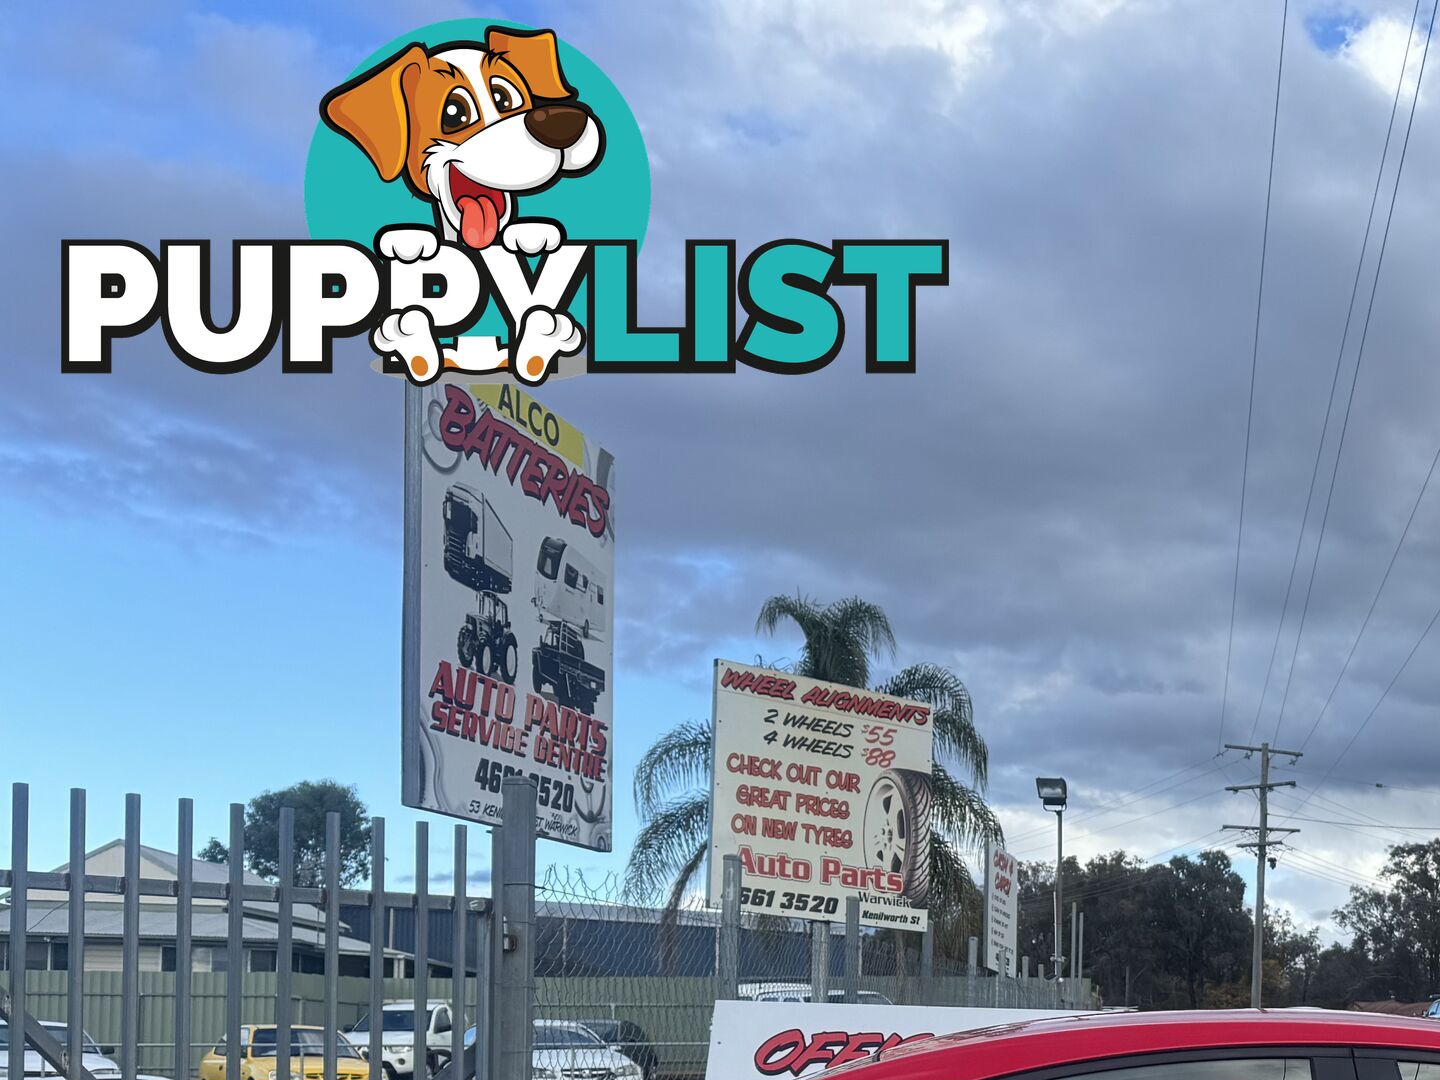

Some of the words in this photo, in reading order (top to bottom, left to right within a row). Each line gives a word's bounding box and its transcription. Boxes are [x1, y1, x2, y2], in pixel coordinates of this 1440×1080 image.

[498, 384, 560, 447] ALCO
[440, 384, 610, 538] BATTERIES
[428, 660, 516, 724] AUTO
[524, 693, 609, 758] PARTS
[720, 667, 798, 700] WHEEL
[802, 684, 931, 726] ALIGNMENTS
[430, 700, 529, 758] SERVICE
[533, 734, 609, 783] CENTRE
[763, 709, 779, 724] 2
[782, 712, 854, 738] WHEELS
[861, 724, 898, 746] $55
[763, 730, 778, 745] 4
[782, 734, 854, 759] WHEELS
[861, 747, 897, 768] $88
[726, 752, 783, 781] CHECK
[786, 763, 822, 787] OUT
[826, 769, 861, 794] OUR
[468, 799, 480, 814] 53
[735, 784, 792, 811] GREAT
[795, 793, 851, 820] PRICES
[730, 814, 757, 836] ON
[762, 817, 798, 841] NEW
[801, 824, 854, 849] TYRES
[738, 844, 812, 882] Auto
[820, 855, 906, 893] Parts
[780, 892, 839, 914] 3520
[858, 891, 910, 908] Warwick
[861, 910, 909, 924] Kenilworth
[910, 915, 921, 926] St
